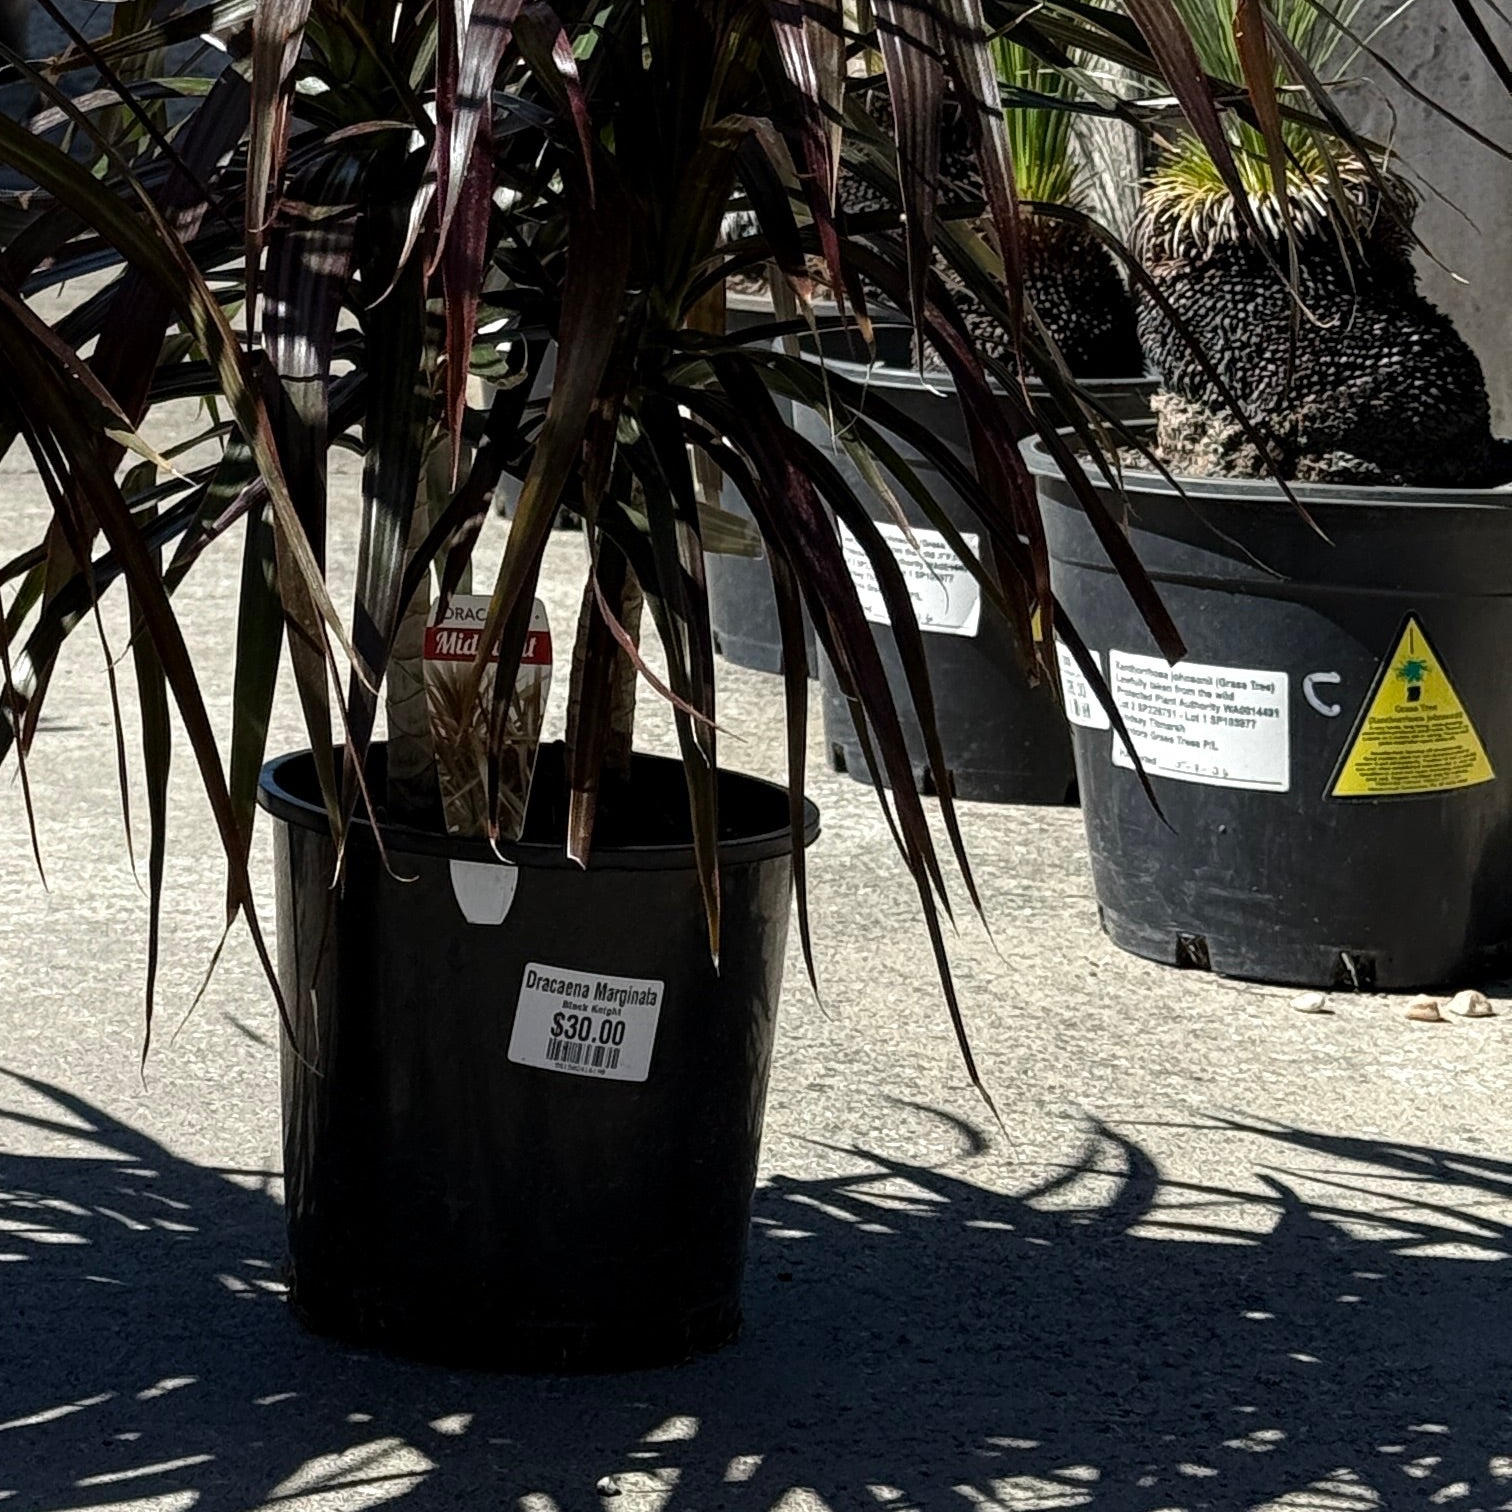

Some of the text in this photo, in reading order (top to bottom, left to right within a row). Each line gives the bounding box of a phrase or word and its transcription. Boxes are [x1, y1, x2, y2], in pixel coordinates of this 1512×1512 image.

[1303, 671, 1341, 717] C
[526, 969, 658, 1007] Dracaena Marginata
[562, 1000, 622, 1017] Black Knight
[550, 1011, 626, 1046] $30.00
